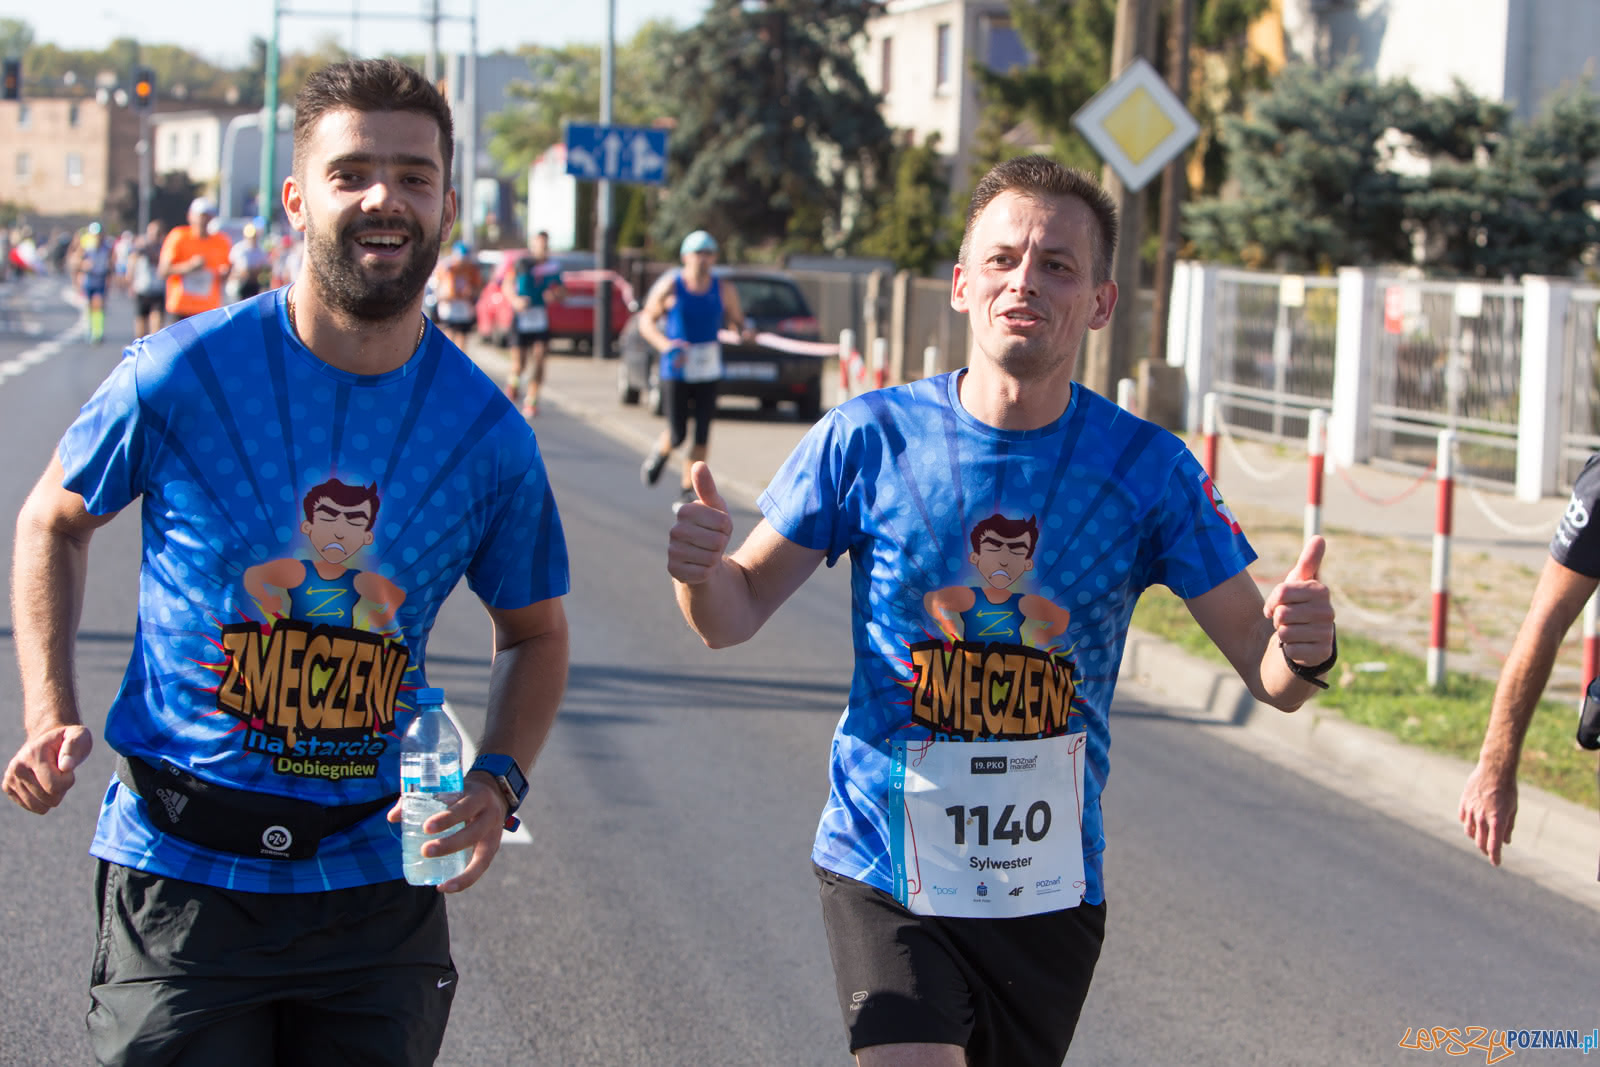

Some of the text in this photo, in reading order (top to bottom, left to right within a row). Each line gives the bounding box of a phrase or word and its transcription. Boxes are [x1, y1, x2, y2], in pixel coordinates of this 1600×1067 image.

[218, 628, 408, 748] ZMĘCZENI
[911, 647, 1072, 742] ZMĘCZENI
[248, 730, 384, 758] na starcie
[277, 757, 376, 779] Dobiegniew
[974, 761, 1005, 770] 19. PKO
[1010, 762, 1037, 771] maraton
[155, 788, 181, 824] adidas
[945, 800, 1052, 846] 1140
[969, 856, 1032, 871] Sylwester
